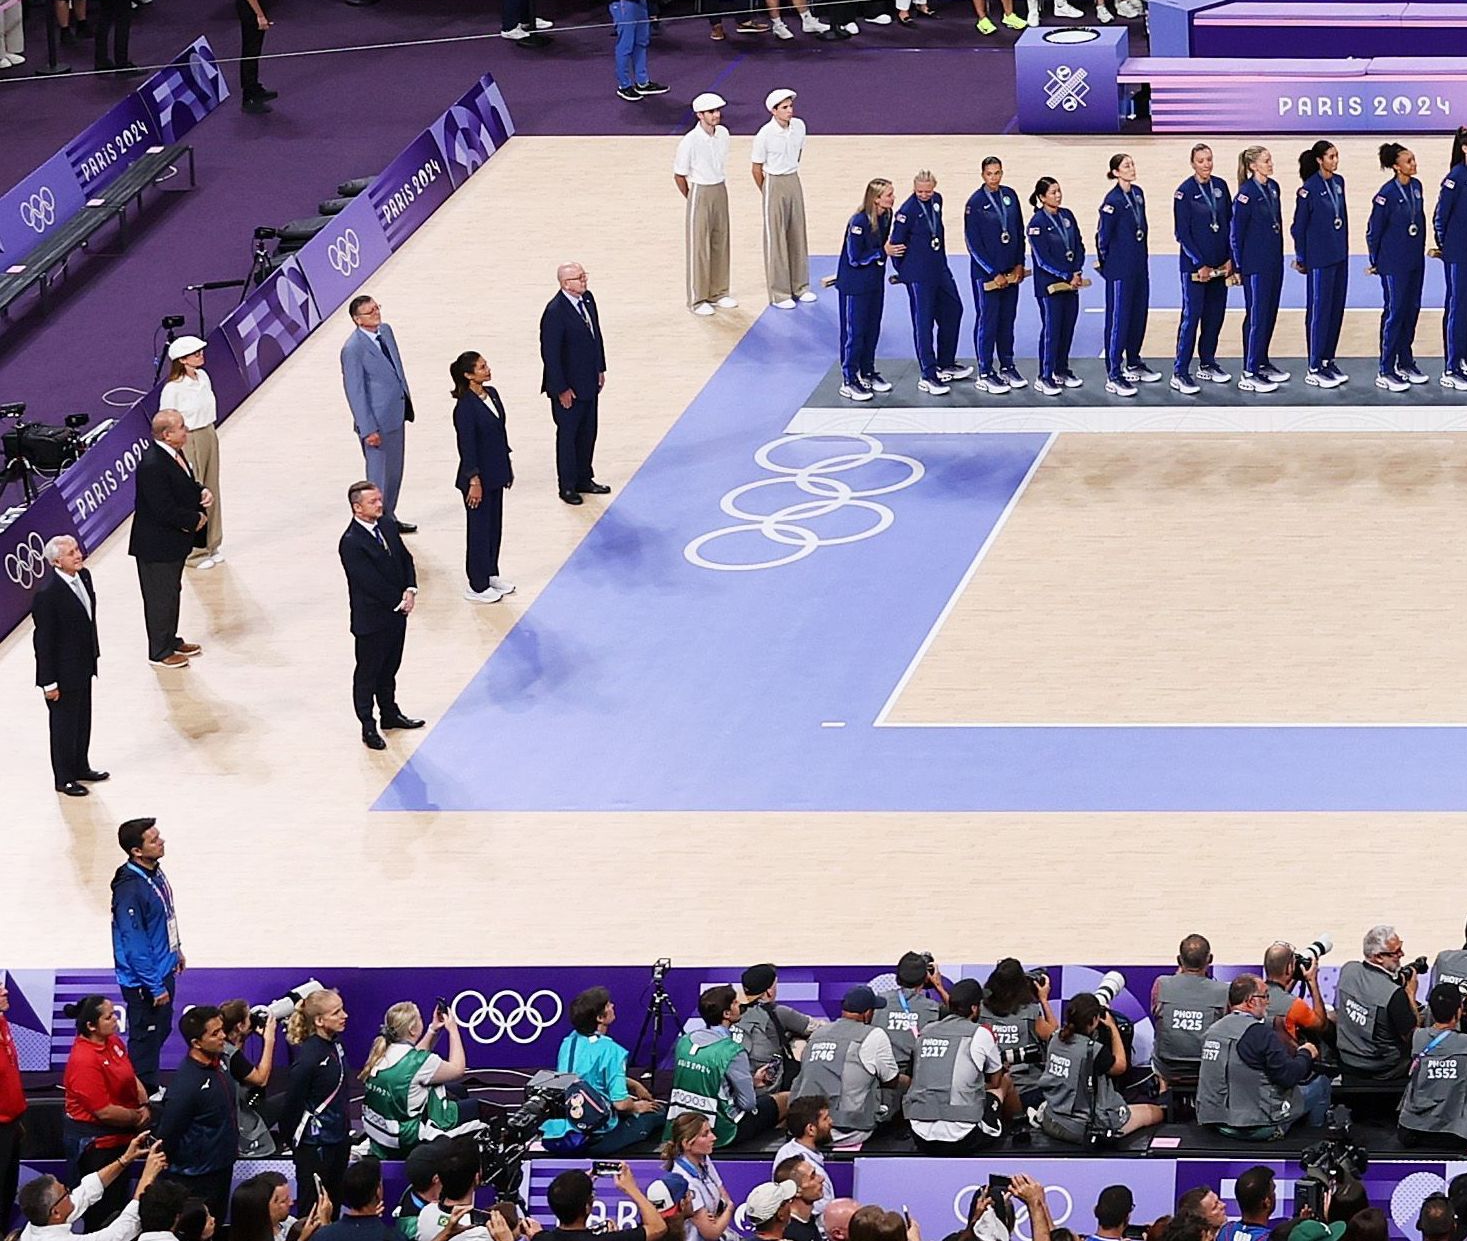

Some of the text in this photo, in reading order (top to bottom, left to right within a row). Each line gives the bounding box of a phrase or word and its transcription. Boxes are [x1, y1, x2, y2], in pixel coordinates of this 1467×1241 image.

[1278, 96, 1450, 116] PARIS 2024
[81, 119, 153, 182] PARIS 2024
[382, 159, 443, 225] PARIS 2024
[76, 467, 119, 522] PARIS
[1346, 1000, 1369, 1015] PHOTO
[889, 1012, 919, 1021] PHOTO
[1173, 1010, 1203, 1019] PHOTO
[1345, 1006, 1367, 1026] 470
[992, 1025, 1019, 1033] PHOTO
[1172, 1018, 1203, 1031] 2425
[811, 1043, 837, 1051] PHOTO
[922, 1039, 950, 1048] PHOTO
[921, 1046, 948, 1058] 3217
[1049, 1054, 1071, 1067] PHOTO
[1427, 1060, 1457, 1069] PHOTO
[1049, 1063, 1070, 1079] 1324
[1427, 1068, 1458, 1079] 1552
